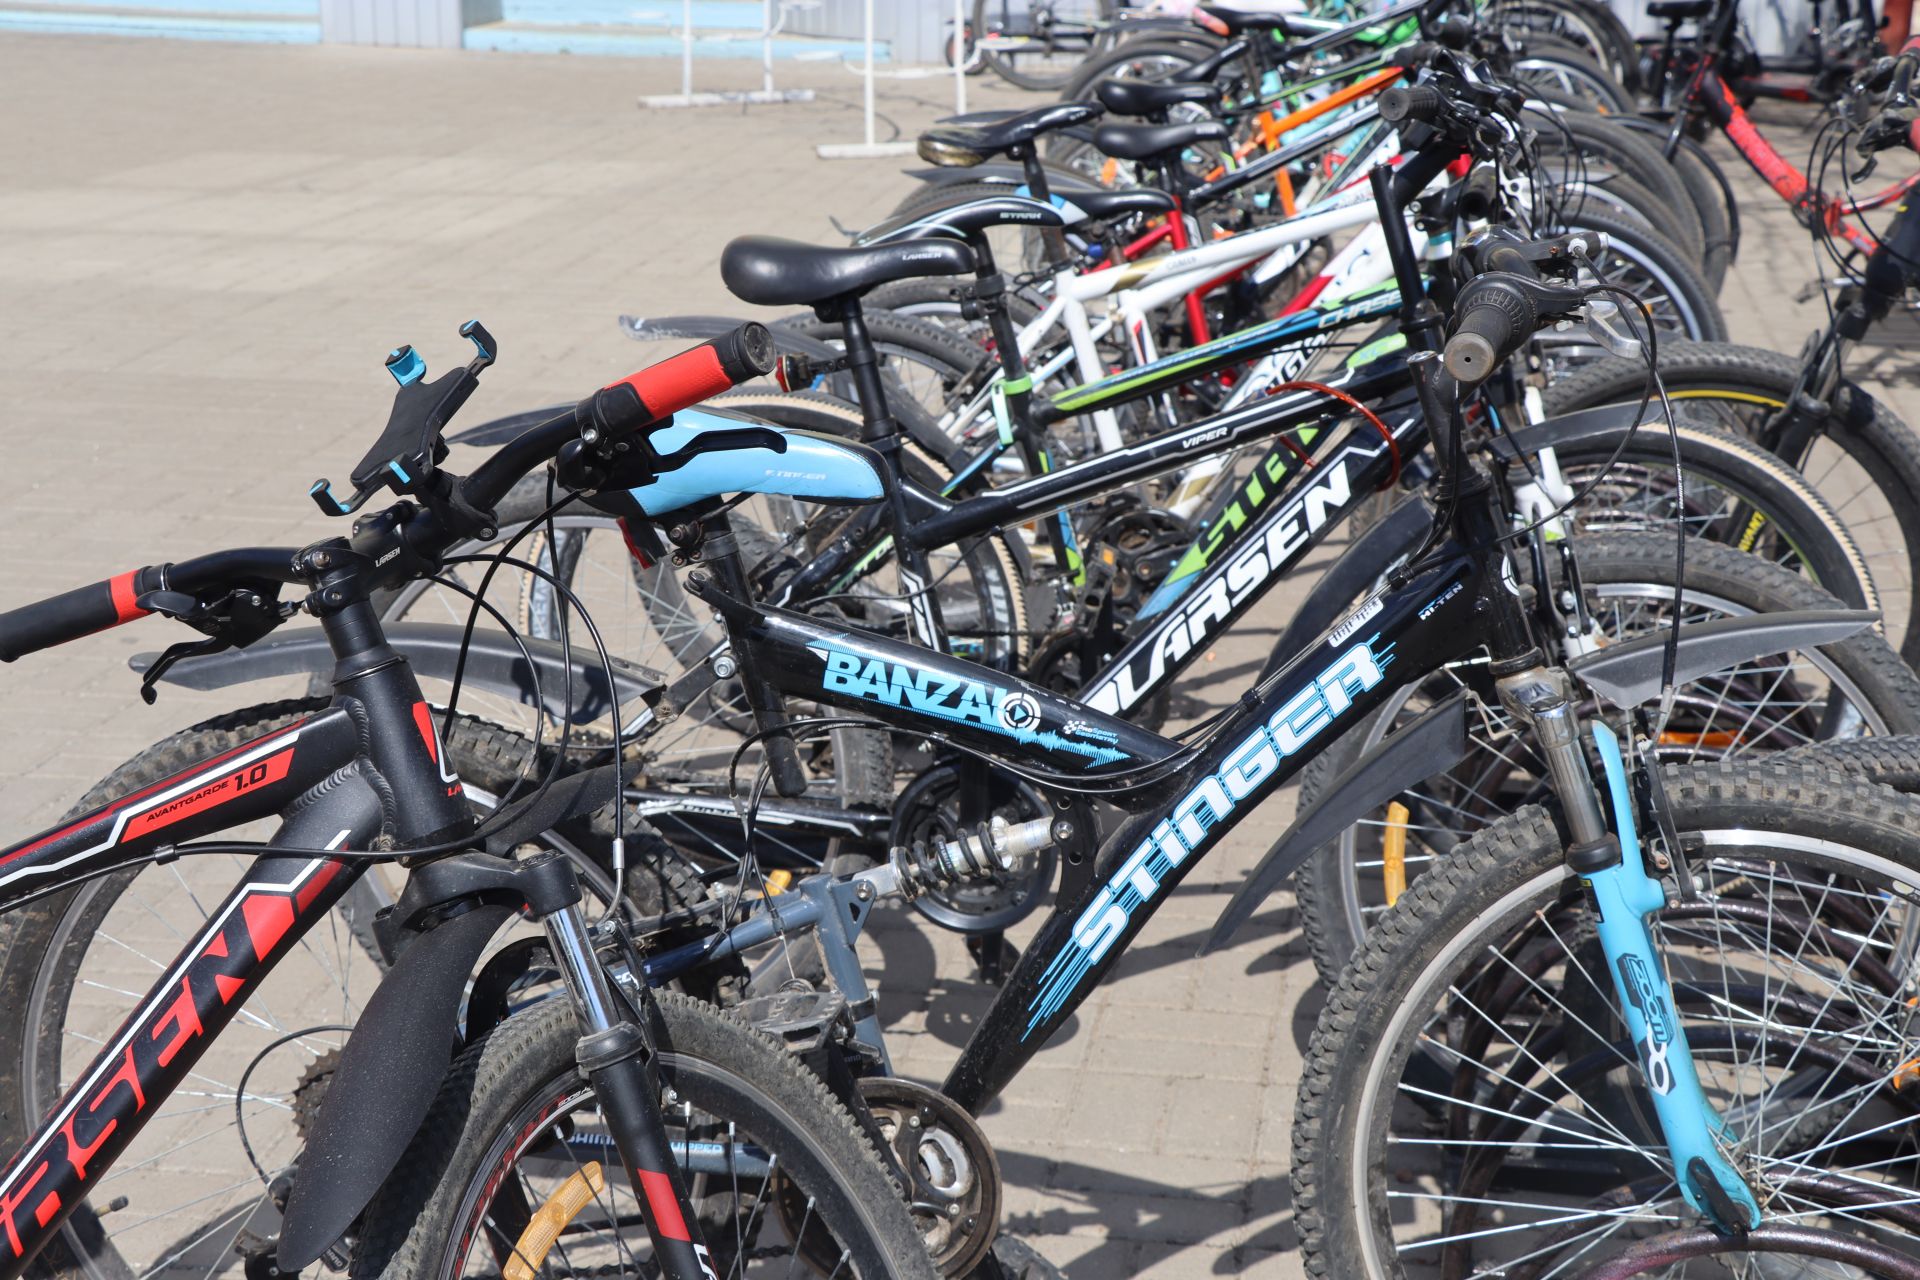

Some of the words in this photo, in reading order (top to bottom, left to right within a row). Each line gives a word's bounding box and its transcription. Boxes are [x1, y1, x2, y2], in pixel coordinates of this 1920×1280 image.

[1181, 426, 1229, 449] VIPER
[374, 546, 401, 569] LARSEN
[1108, 460, 1352, 712] LARSEN
[1420, 583, 1464, 621] HI-TEN
[823, 651, 1008, 731] BANZAI
[146, 780, 229, 823] AVANTGARDE
[233, 763, 268, 792] 1.0
[1629, 955, 1669, 1045] ZOOM
[0, 904, 260, 1258] RSEN
